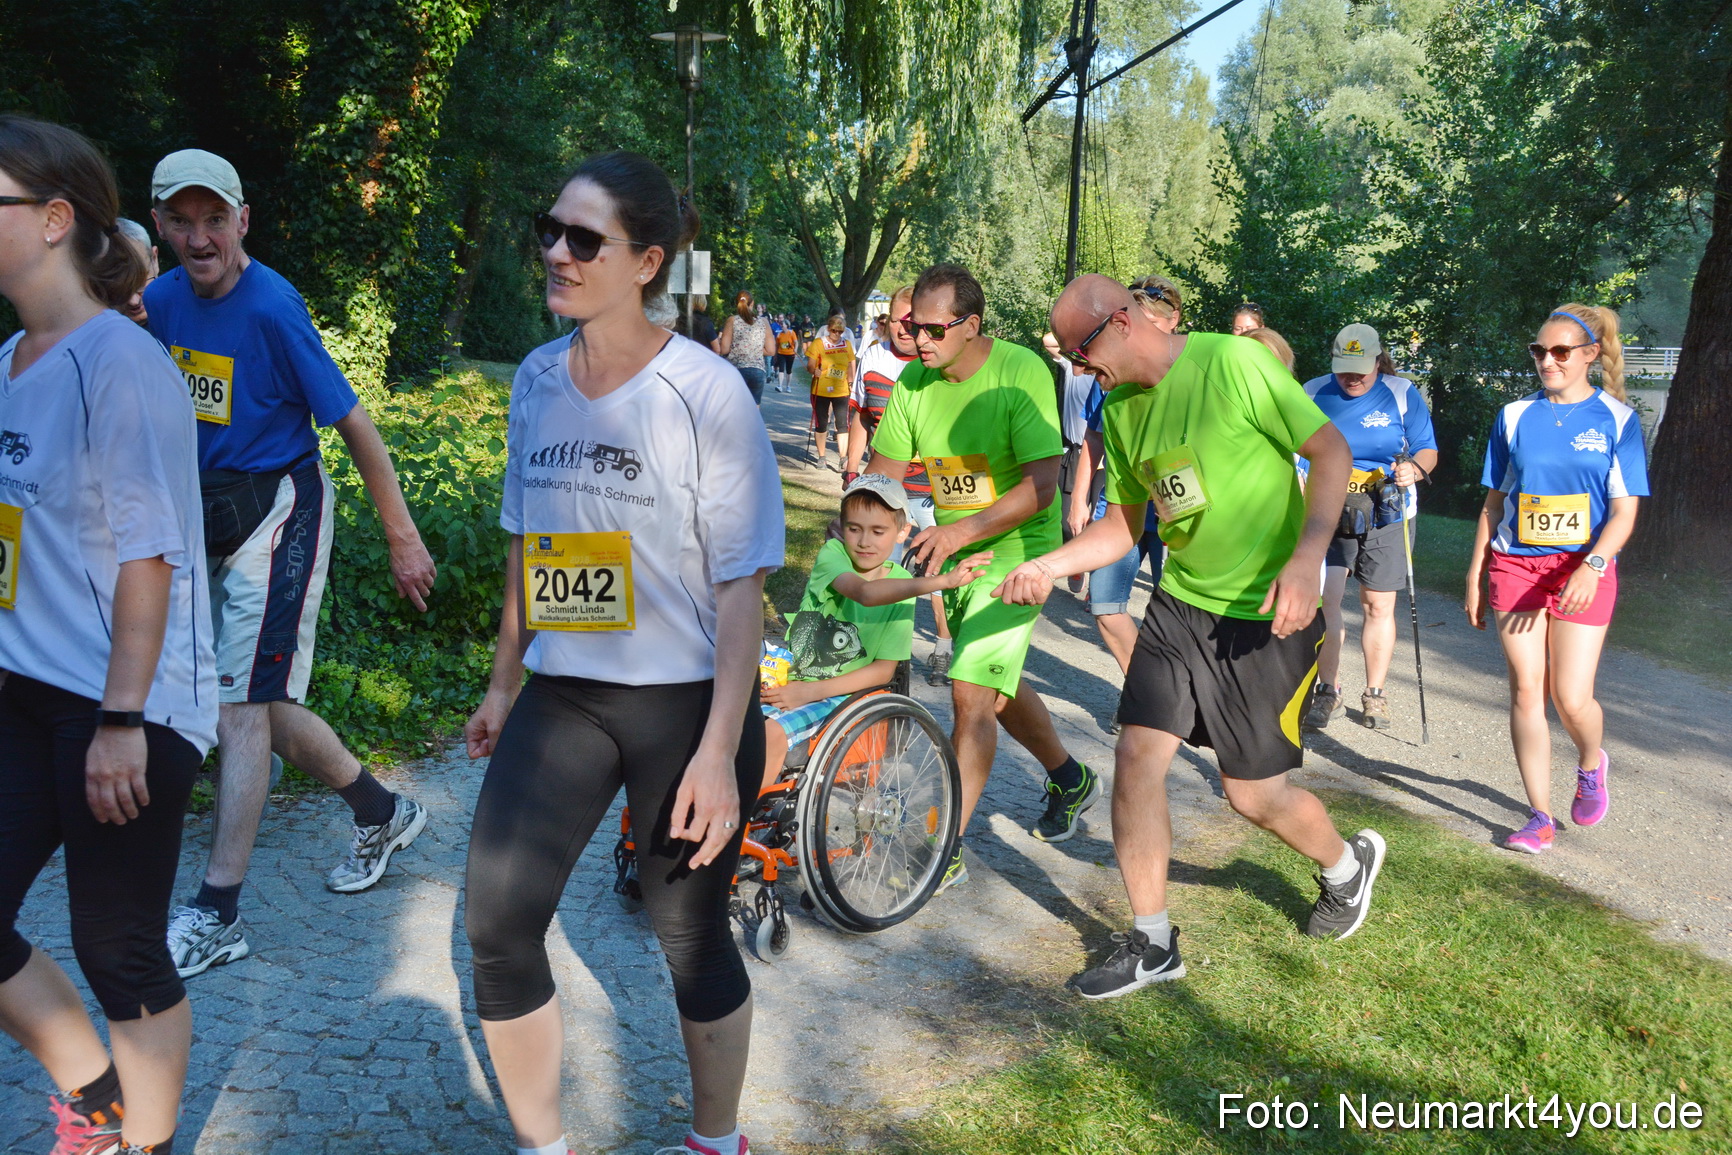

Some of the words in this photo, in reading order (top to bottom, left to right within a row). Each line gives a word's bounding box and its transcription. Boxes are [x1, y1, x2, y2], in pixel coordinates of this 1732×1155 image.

[182, 372, 224, 404] 096
[940, 475, 976, 495] 349
[1152, 475, 1186, 505] 346
[604, 486, 656, 508] Schmidt
[1179, 494, 1197, 505] Aaron
[1526, 513, 1580, 531] 1974
[534, 568, 616, 603] 2042
[538, 614, 571, 623] Waldkalkung
[545, 604, 578, 614] Schmidt
[580, 605, 605, 614] Linda
